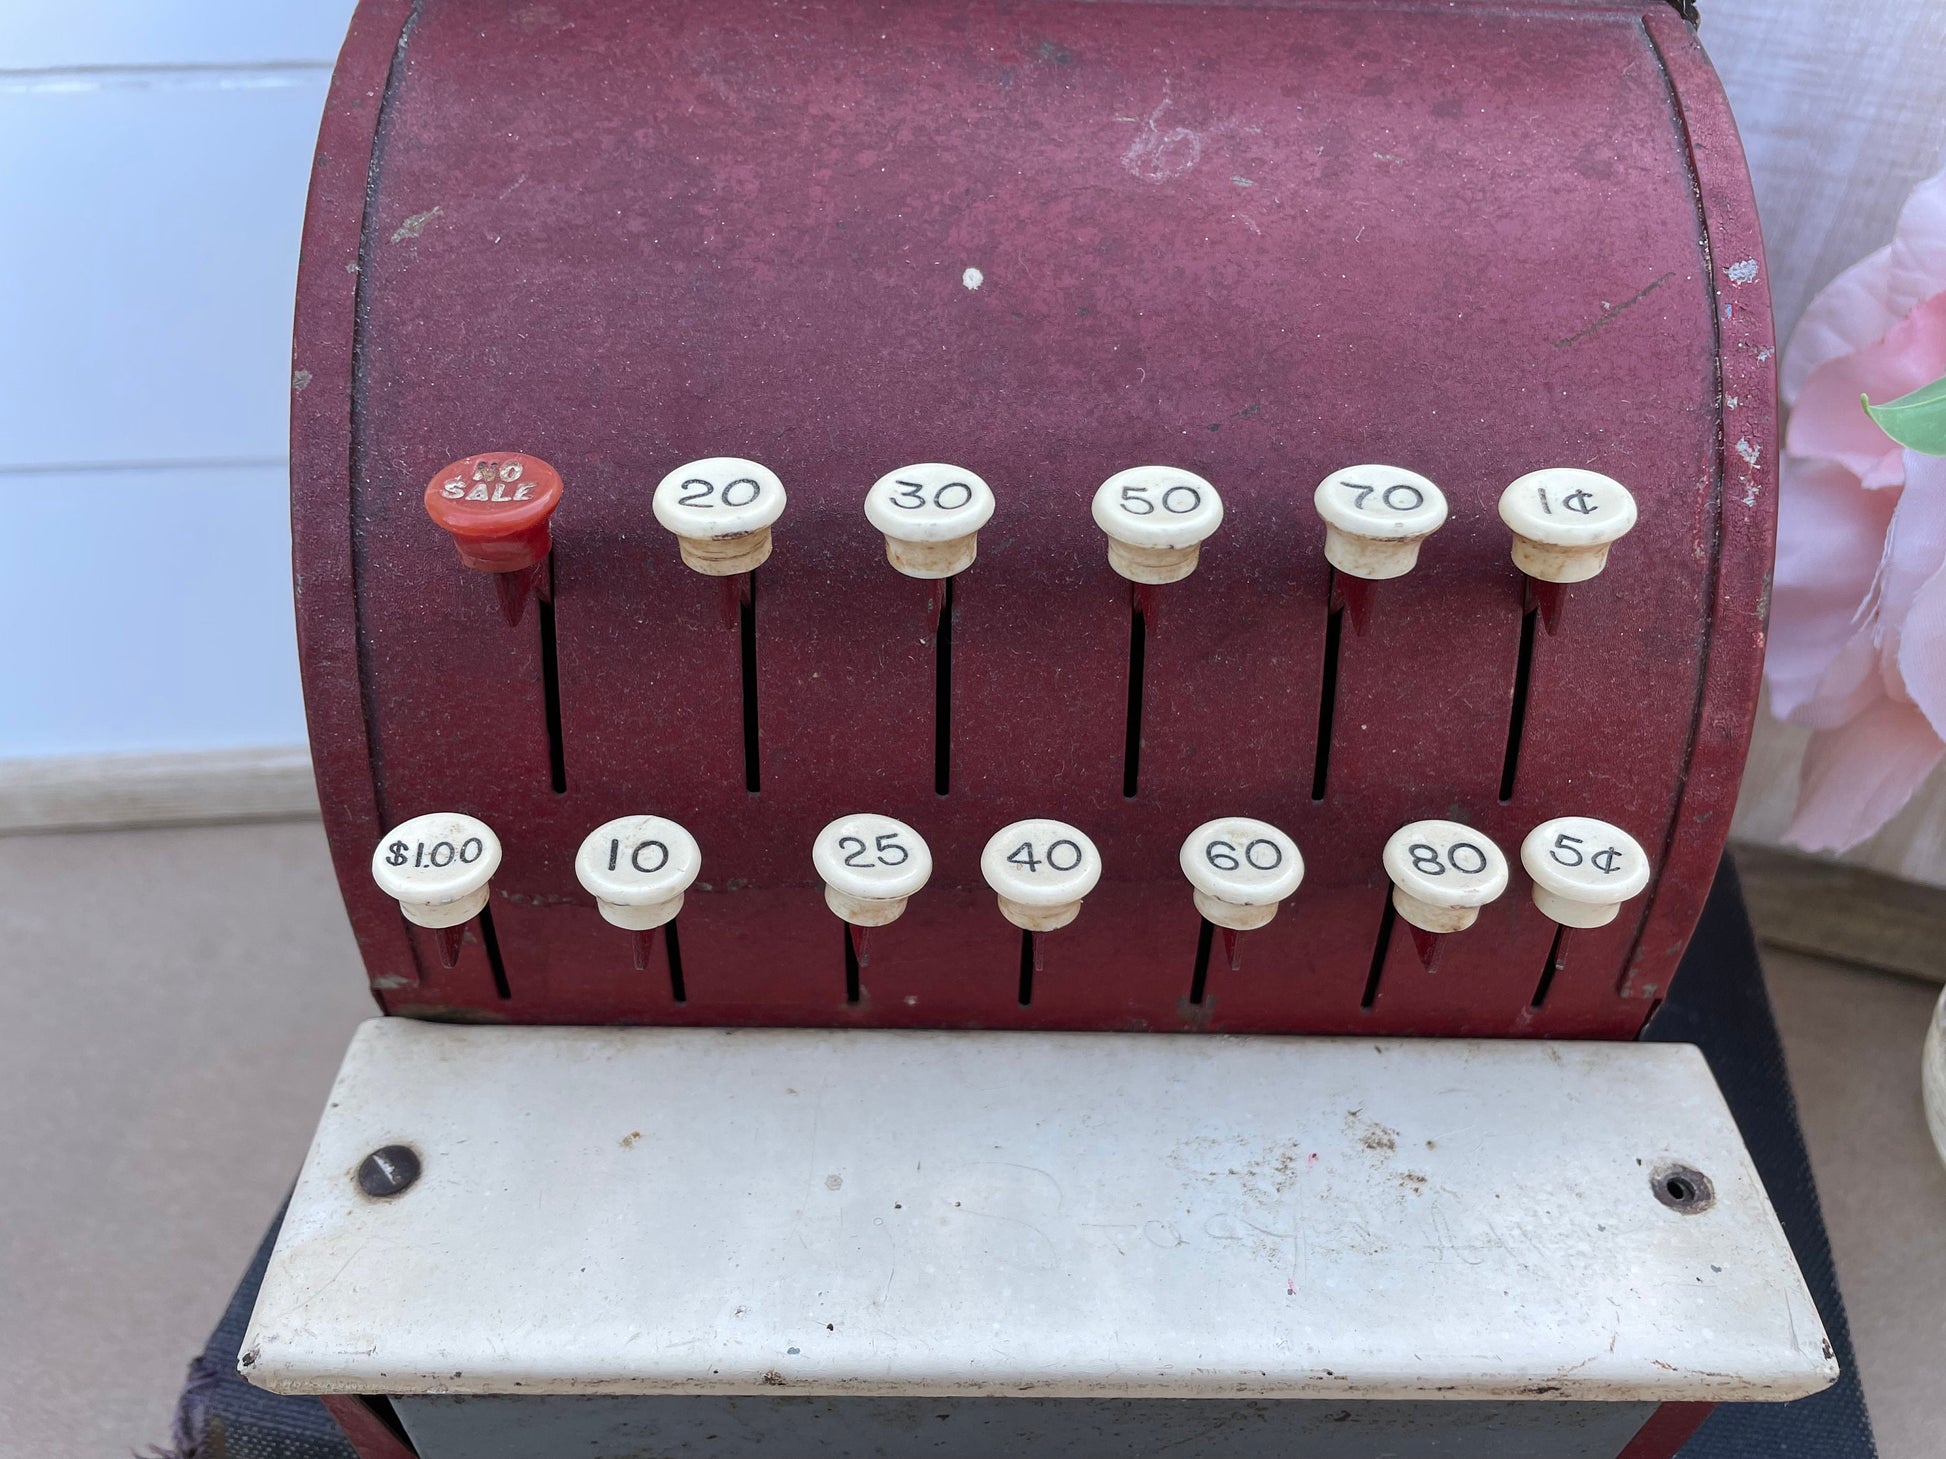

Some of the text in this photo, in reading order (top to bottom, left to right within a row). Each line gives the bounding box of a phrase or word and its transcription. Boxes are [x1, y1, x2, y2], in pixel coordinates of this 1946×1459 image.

[472, 460, 524, 482] NO
[440, 475, 538, 502] SALE
[678, 478, 762, 507] 20
[889, 481, 973, 510] 30
[1121, 485, 1201, 515] 50
[1341, 482, 1425, 511] 70
[1537, 487, 1599, 515] 1¢
[607, 838, 670, 873] 10
[838, 832, 910, 868] 25
[1006, 839, 1083, 873] 40
[1205, 838, 1283, 871] 60
[1408, 842, 1488, 876] 80
[1549, 834, 1624, 875] 5¢
